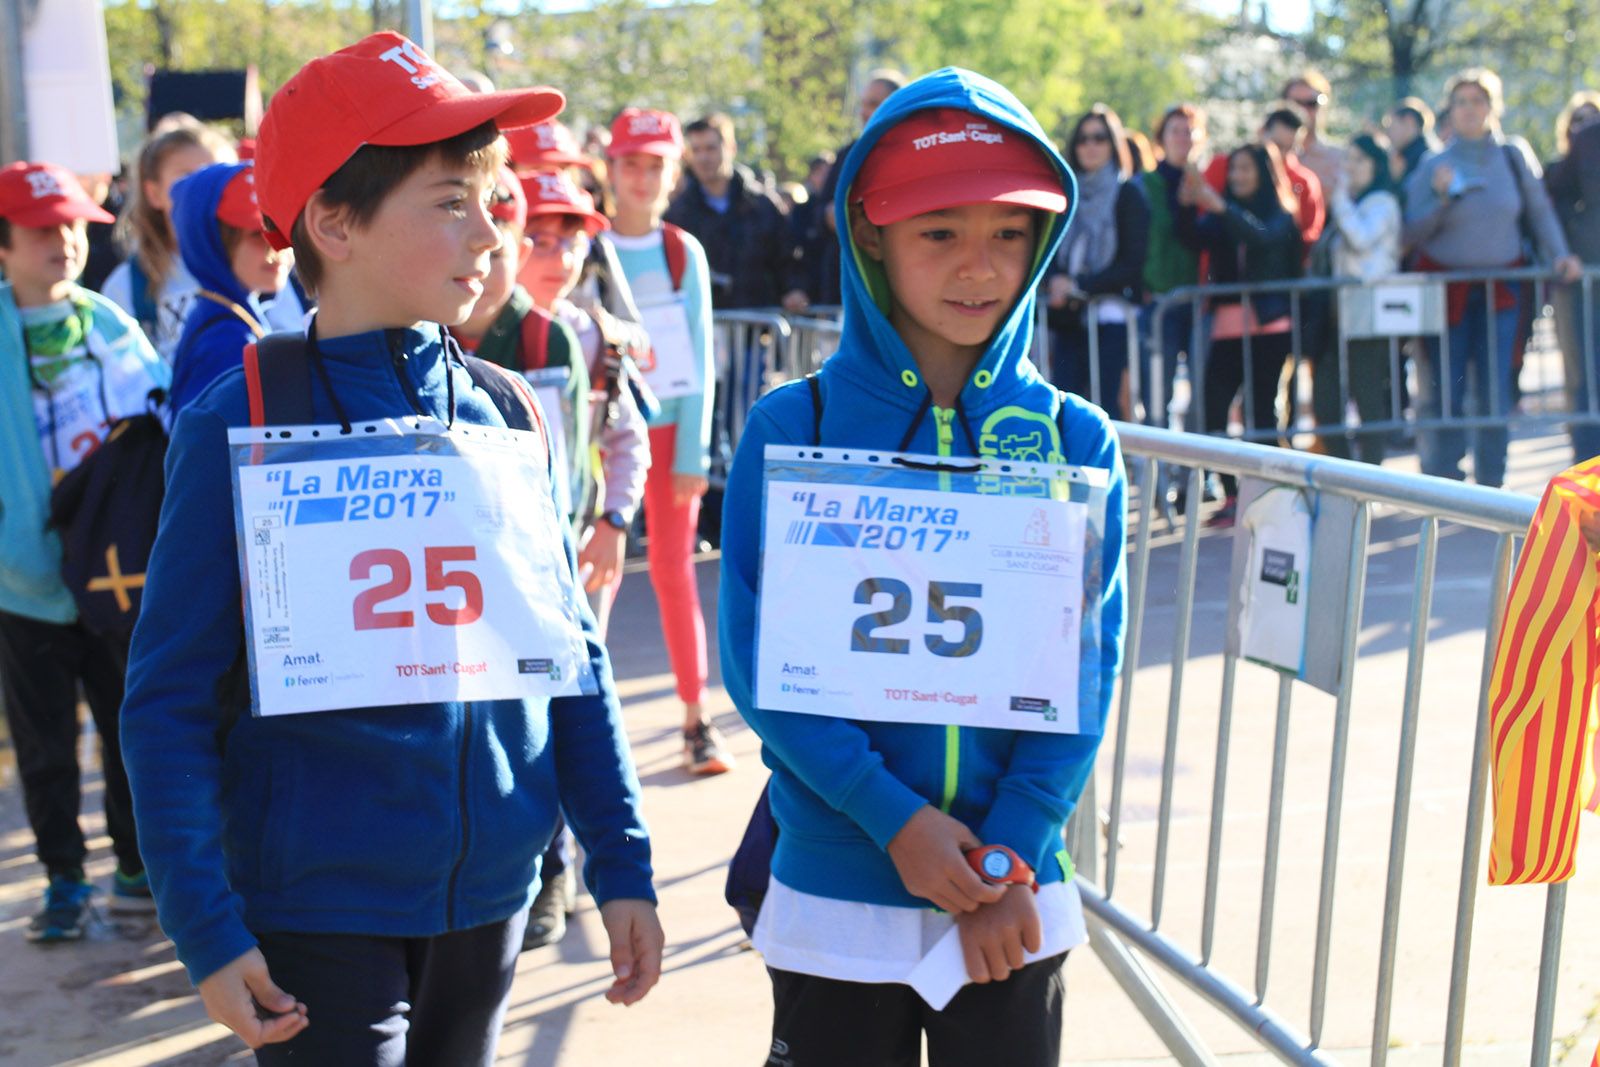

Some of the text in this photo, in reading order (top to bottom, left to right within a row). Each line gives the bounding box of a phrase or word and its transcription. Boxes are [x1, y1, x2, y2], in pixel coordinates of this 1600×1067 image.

[336, 464, 443, 492] Marxa
[854, 495, 959, 525] Marxa
[349, 546, 484, 631] 25
[850, 576, 984, 658] 25
[453, 661, 488, 676] Cugat
[298, 676, 328, 686] ferrer
[793, 683, 820, 694] ferrer
[943, 692, 978, 705] Cugat
